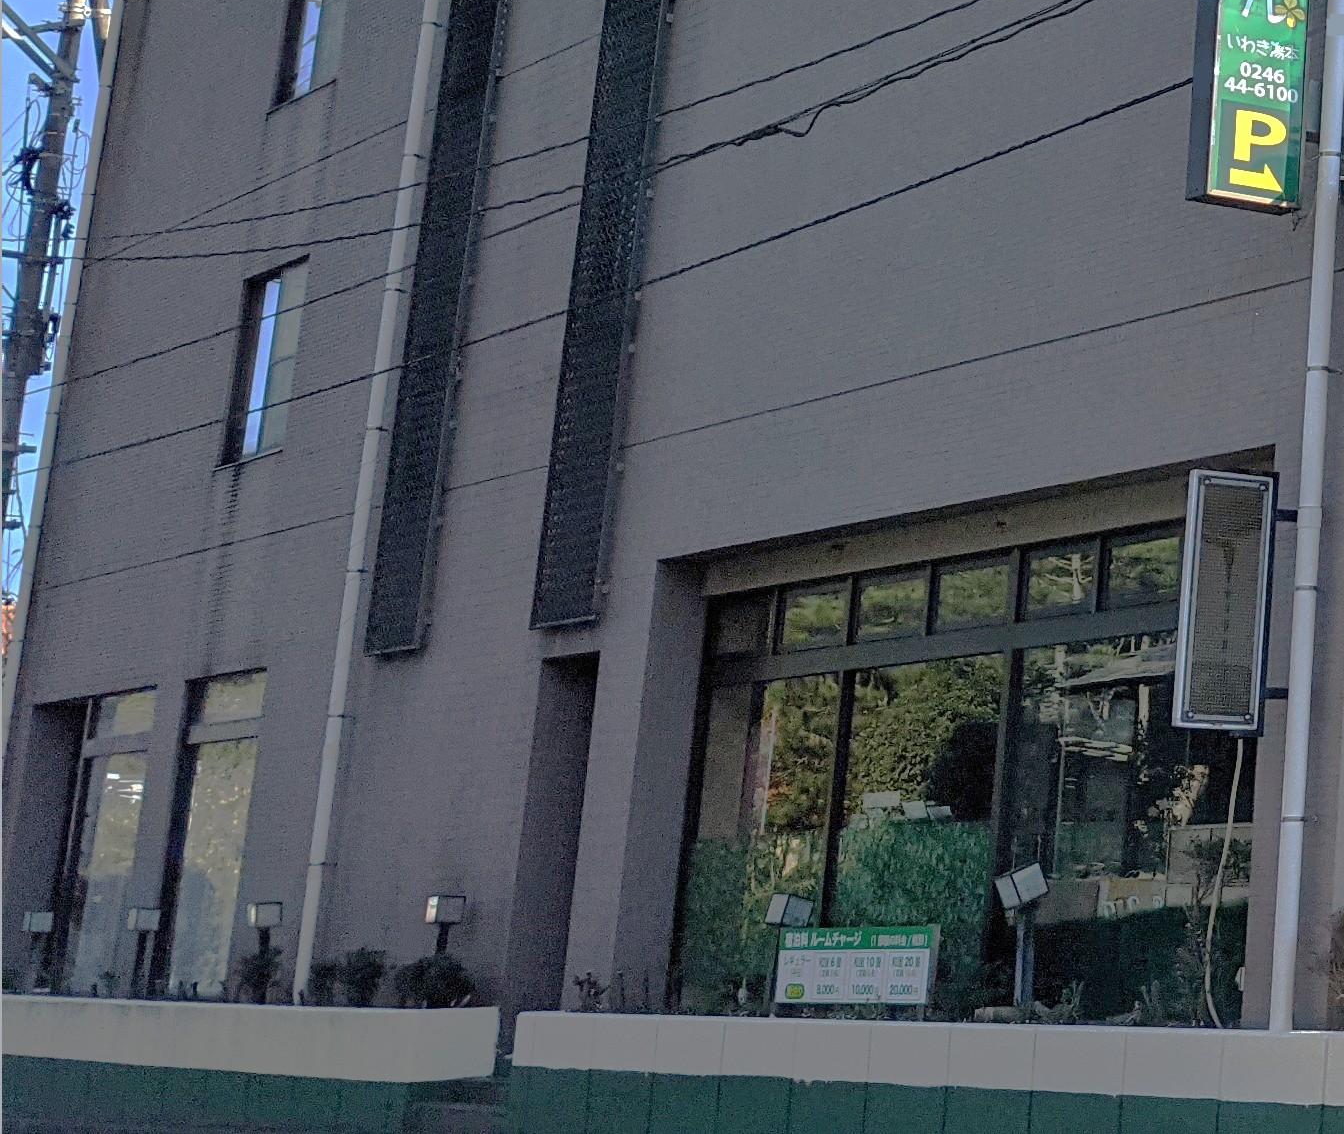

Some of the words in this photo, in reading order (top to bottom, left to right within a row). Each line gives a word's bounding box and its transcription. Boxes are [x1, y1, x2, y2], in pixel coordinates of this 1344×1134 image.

[1240, 61, 1285, 84] 0246
[1224, 76, 1298, 103] 44-6100
[1233, 109, 1287, 162] P
[809, 930, 863, 947] ルームチャージ
